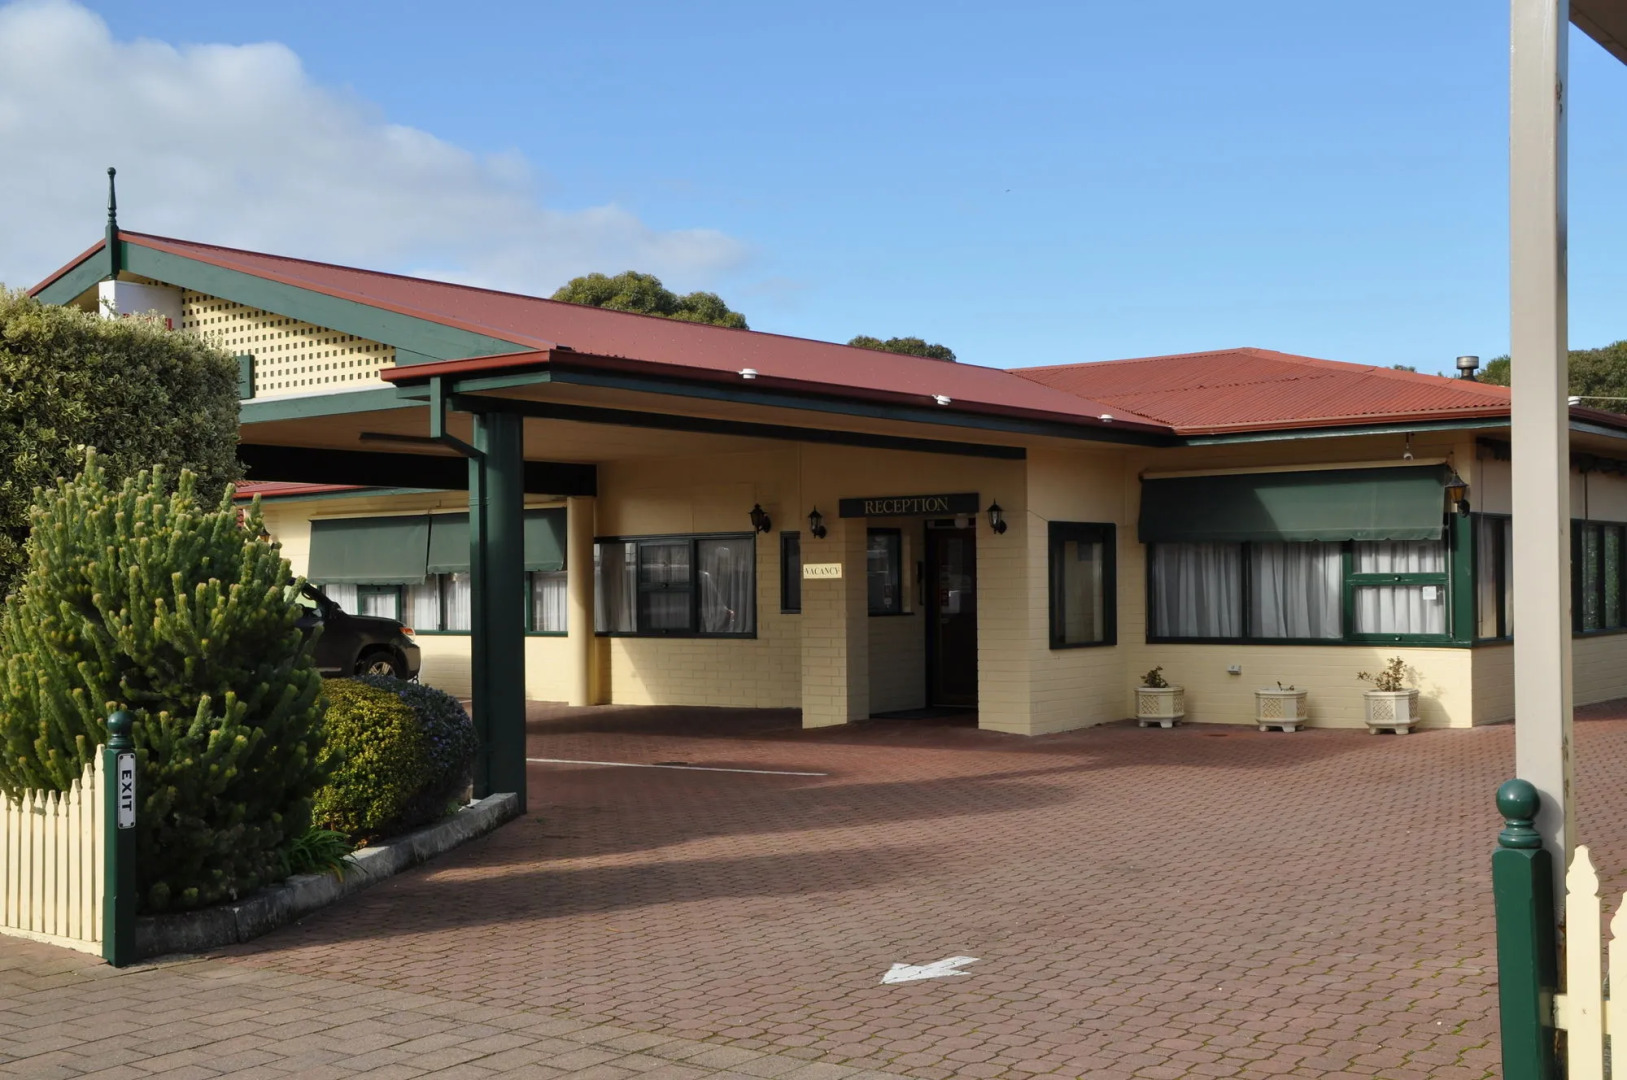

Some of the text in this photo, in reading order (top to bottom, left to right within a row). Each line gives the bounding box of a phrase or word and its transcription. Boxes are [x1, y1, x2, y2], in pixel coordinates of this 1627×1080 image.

[865, 497, 948, 514] RECEPTION
[804, 566, 840, 576] VACANCY
[122, 770, 132, 811] EXIT
